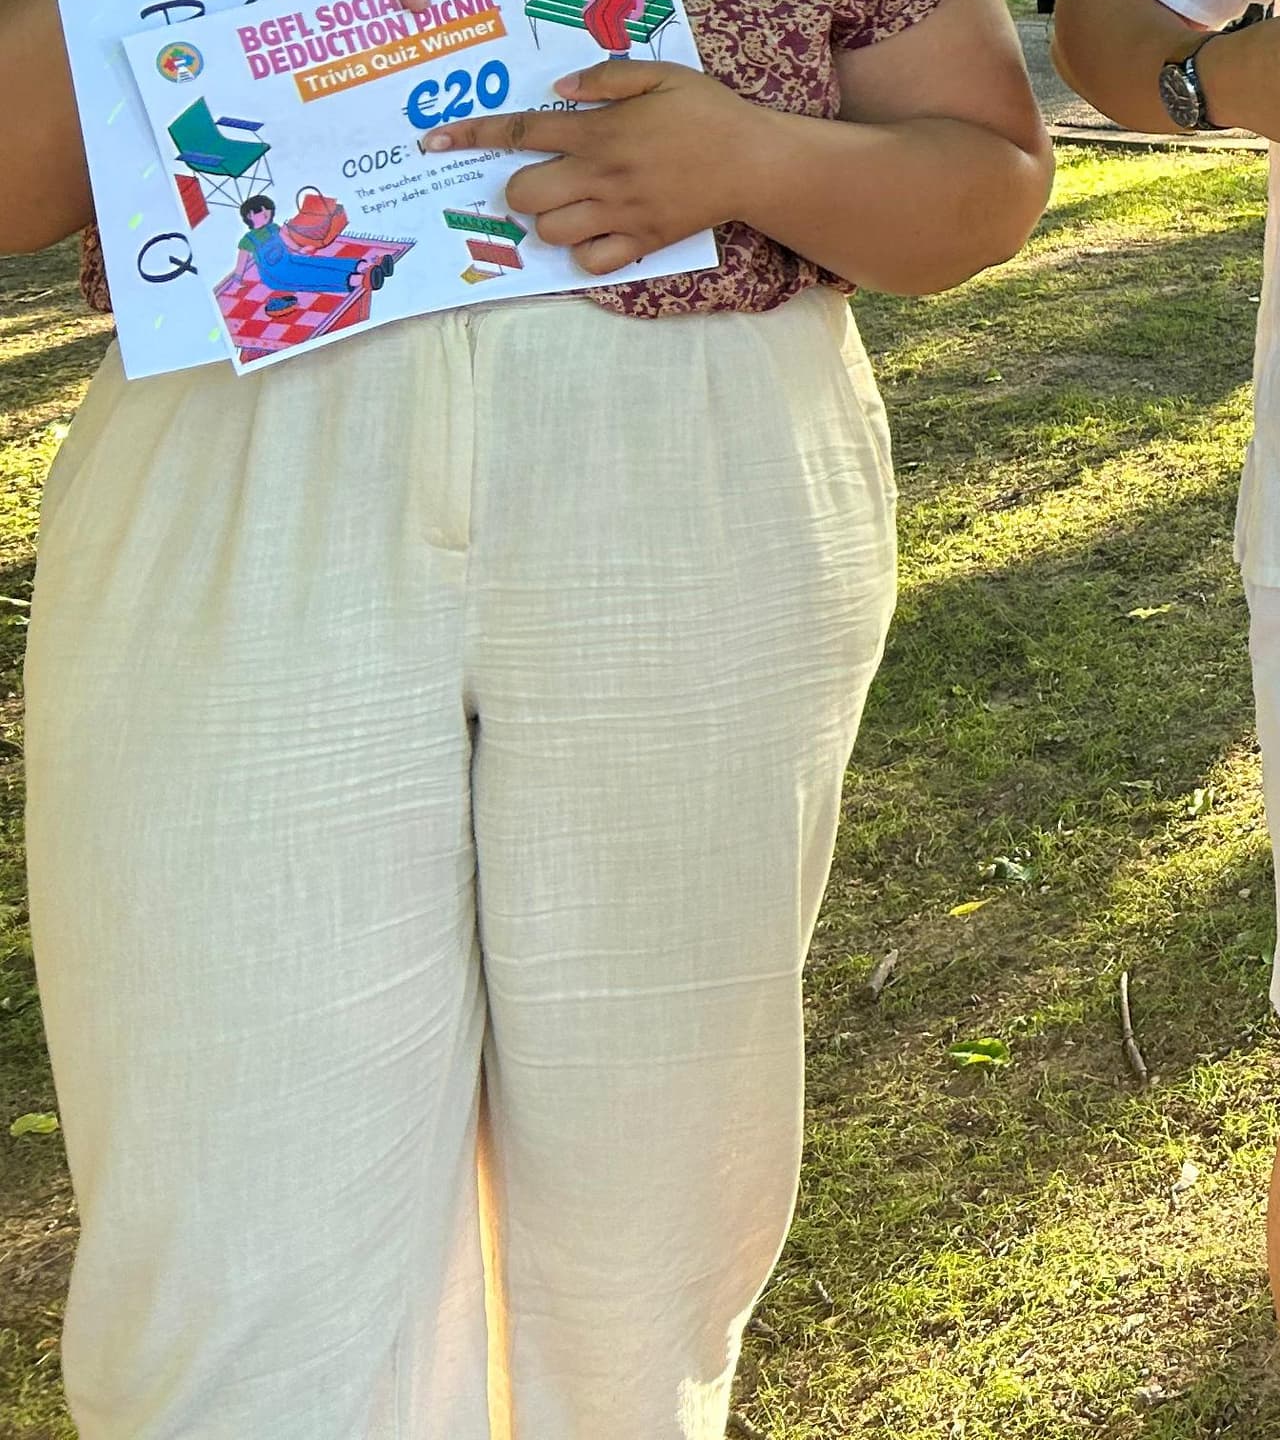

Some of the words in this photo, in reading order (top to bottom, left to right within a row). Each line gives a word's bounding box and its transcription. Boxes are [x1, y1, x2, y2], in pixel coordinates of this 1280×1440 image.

[237, 12, 314, 53] BGFL
[247, 14, 409, 80] DEDUCTION
[303, 63, 368, 93] Trivia
[371, 45, 419, 70] Quiz
[422, 19, 496, 53] Winner
[402, 60, 510, 129] €20
[342, 144, 410, 178] CODE:
[356, 188, 376, 200] The
[379, 173, 422, 192] voucher
[427, 169, 438, 179] is
[441, 150, 500, 174] redeemable
[362, 198, 398, 215] Expiry
[401, 188, 429, 202] date:
